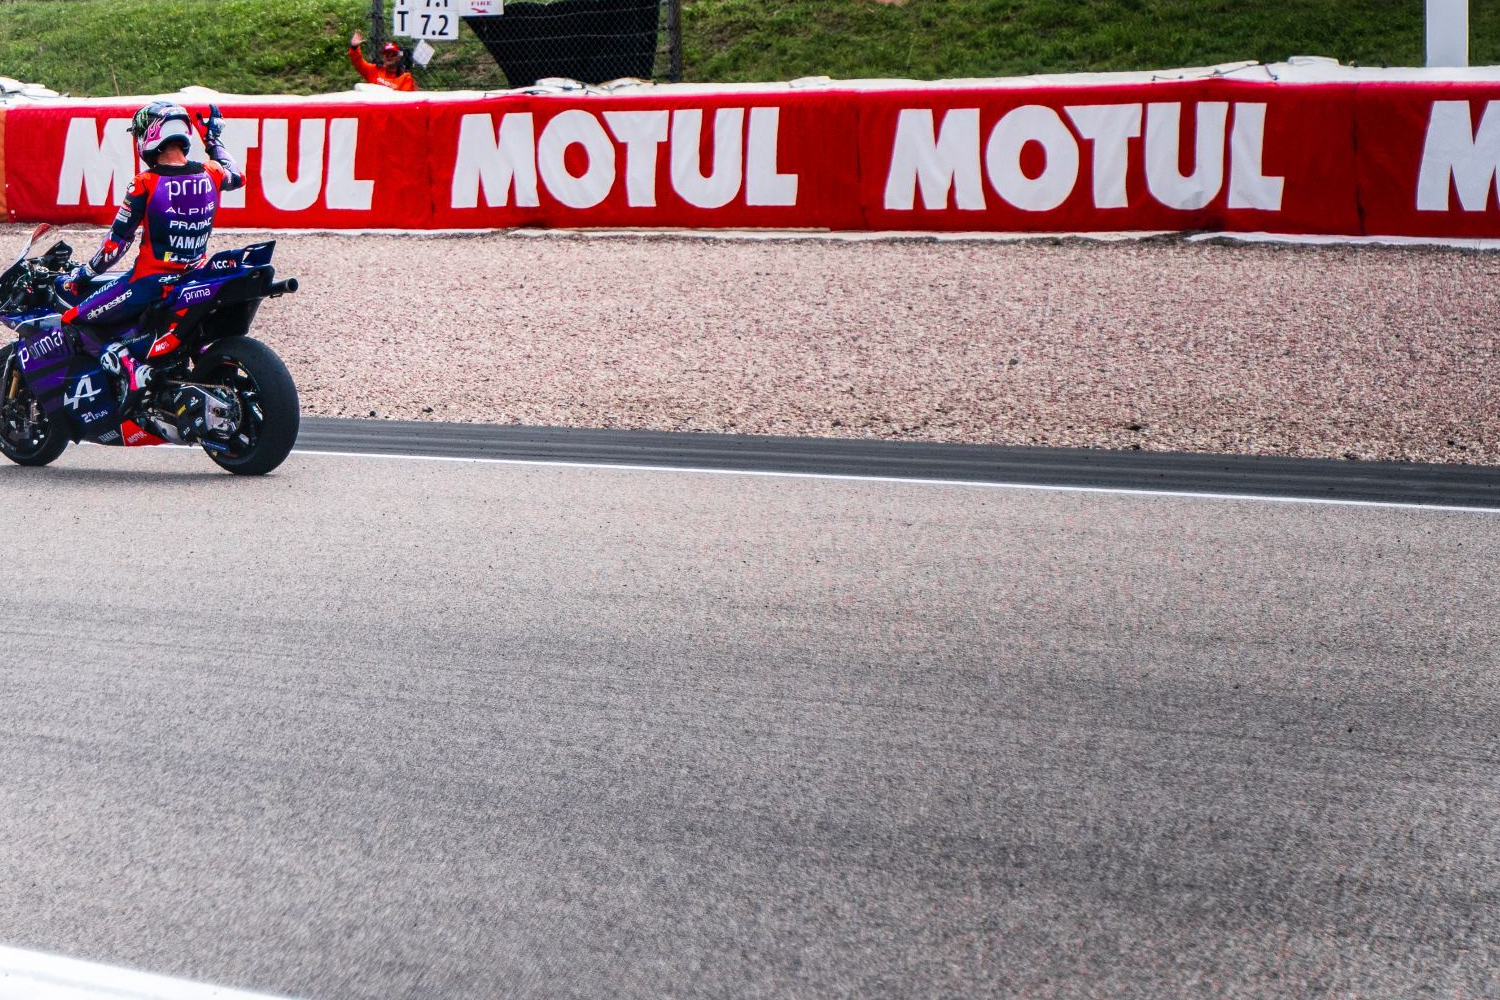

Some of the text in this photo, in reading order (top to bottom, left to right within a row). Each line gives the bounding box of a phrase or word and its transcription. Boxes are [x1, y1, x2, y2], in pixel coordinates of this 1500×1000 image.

[397, 10, 449, 36] T 7.2
[451, 107, 798, 209] MOTUL
[884, 102, 1284, 212] MOTUL
[86, 288, 133, 320] alpinestars
[183, 287, 211, 303] prima
